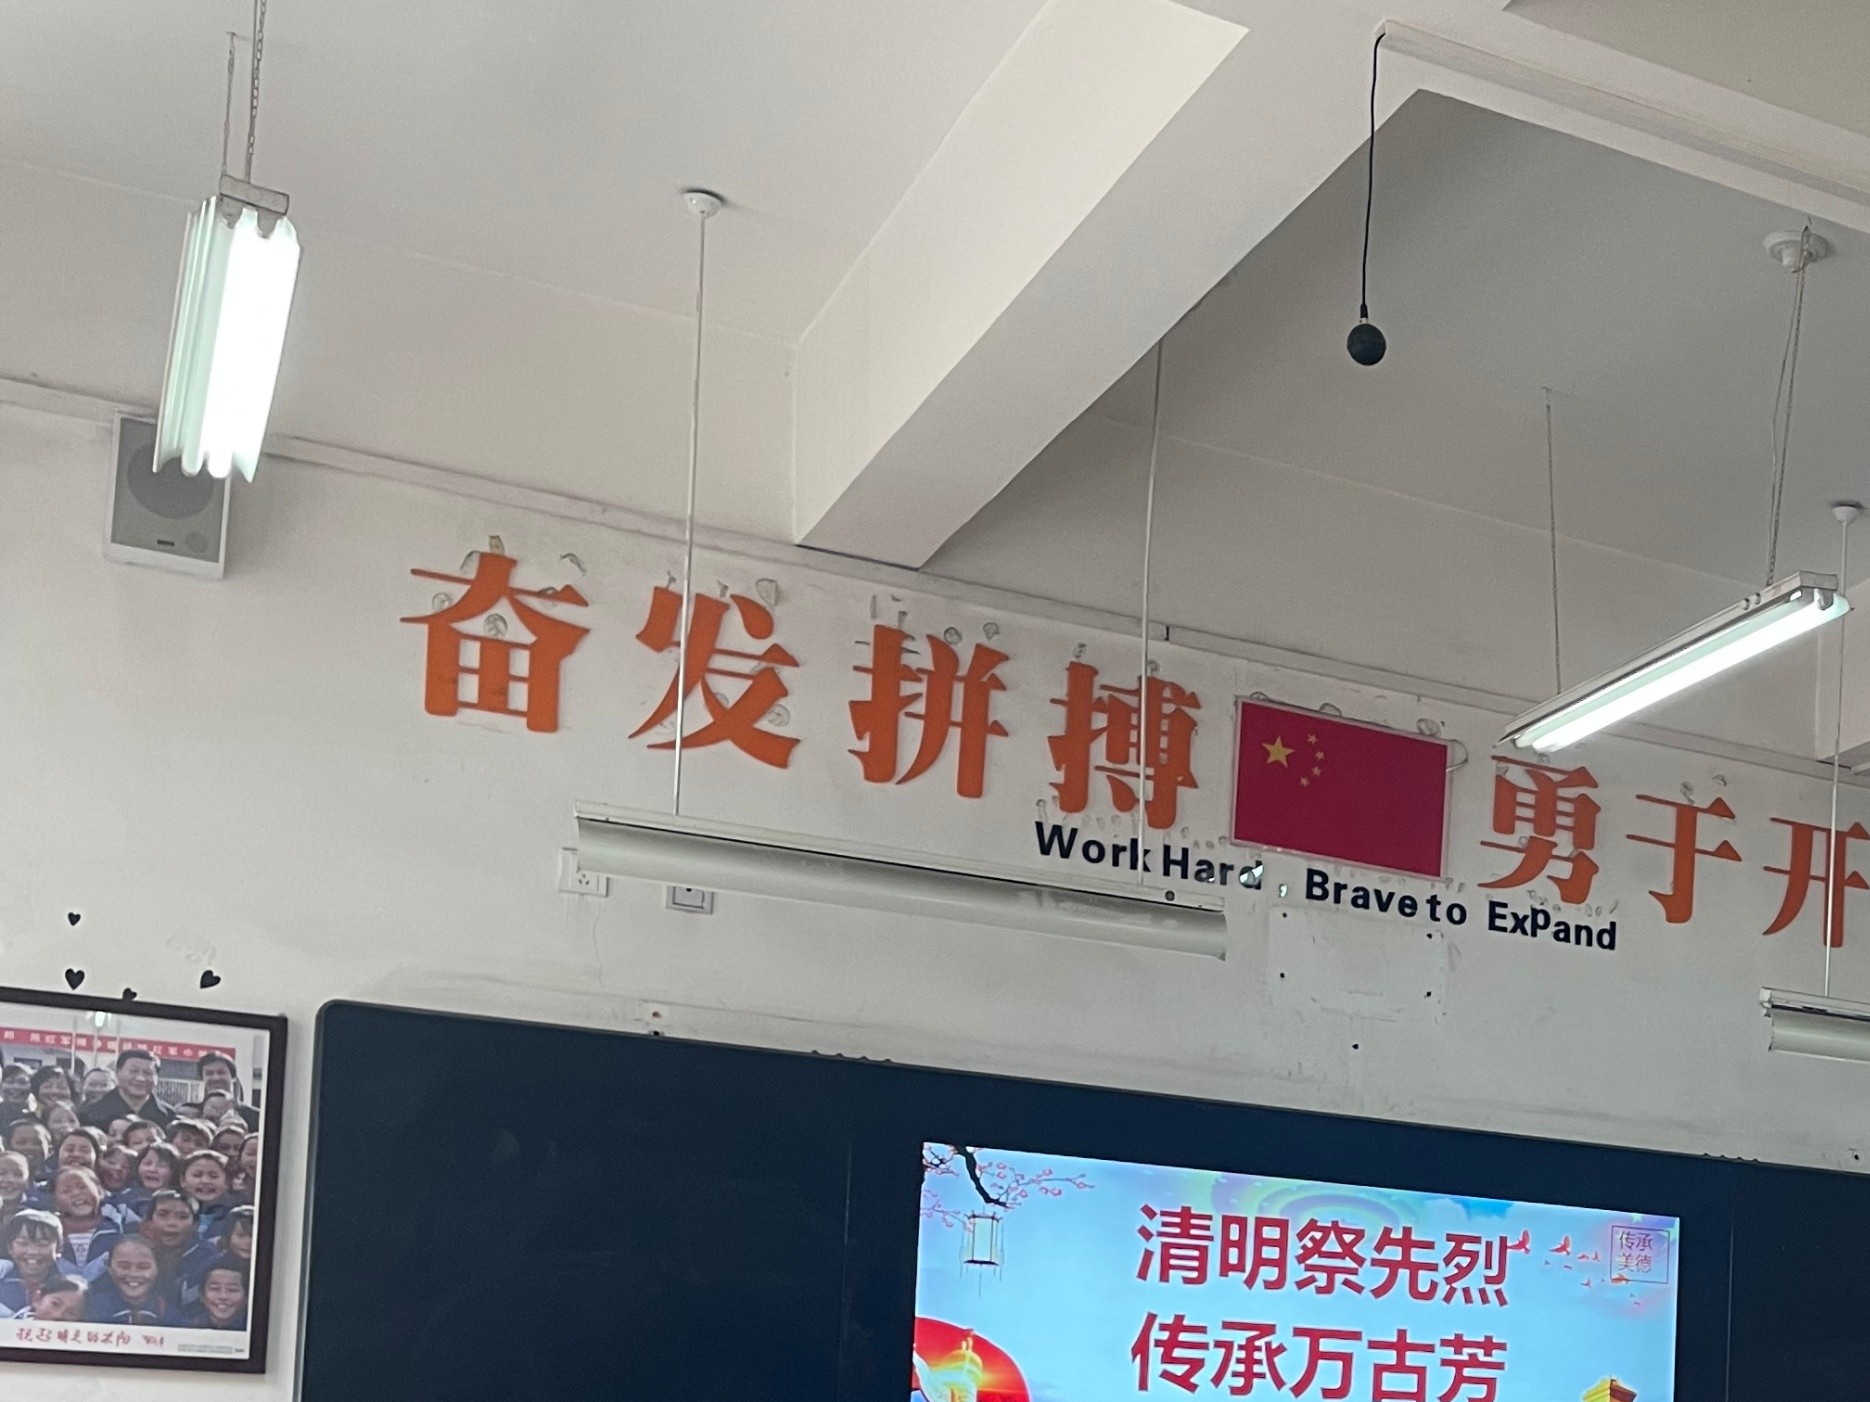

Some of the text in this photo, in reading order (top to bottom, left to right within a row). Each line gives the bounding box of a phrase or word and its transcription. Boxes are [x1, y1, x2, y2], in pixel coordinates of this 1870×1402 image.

[400, 552, 1202, 830] 奋发拼搏
[1034, 820, 1150, 873] Work
[1305, 868, 1418, 918] Brave
[1427, 891, 1468, 926] to
[1135, 1203, 1511, 1308] 清明祭先烈
[1619, 1229, 1654, 1252] 传承
